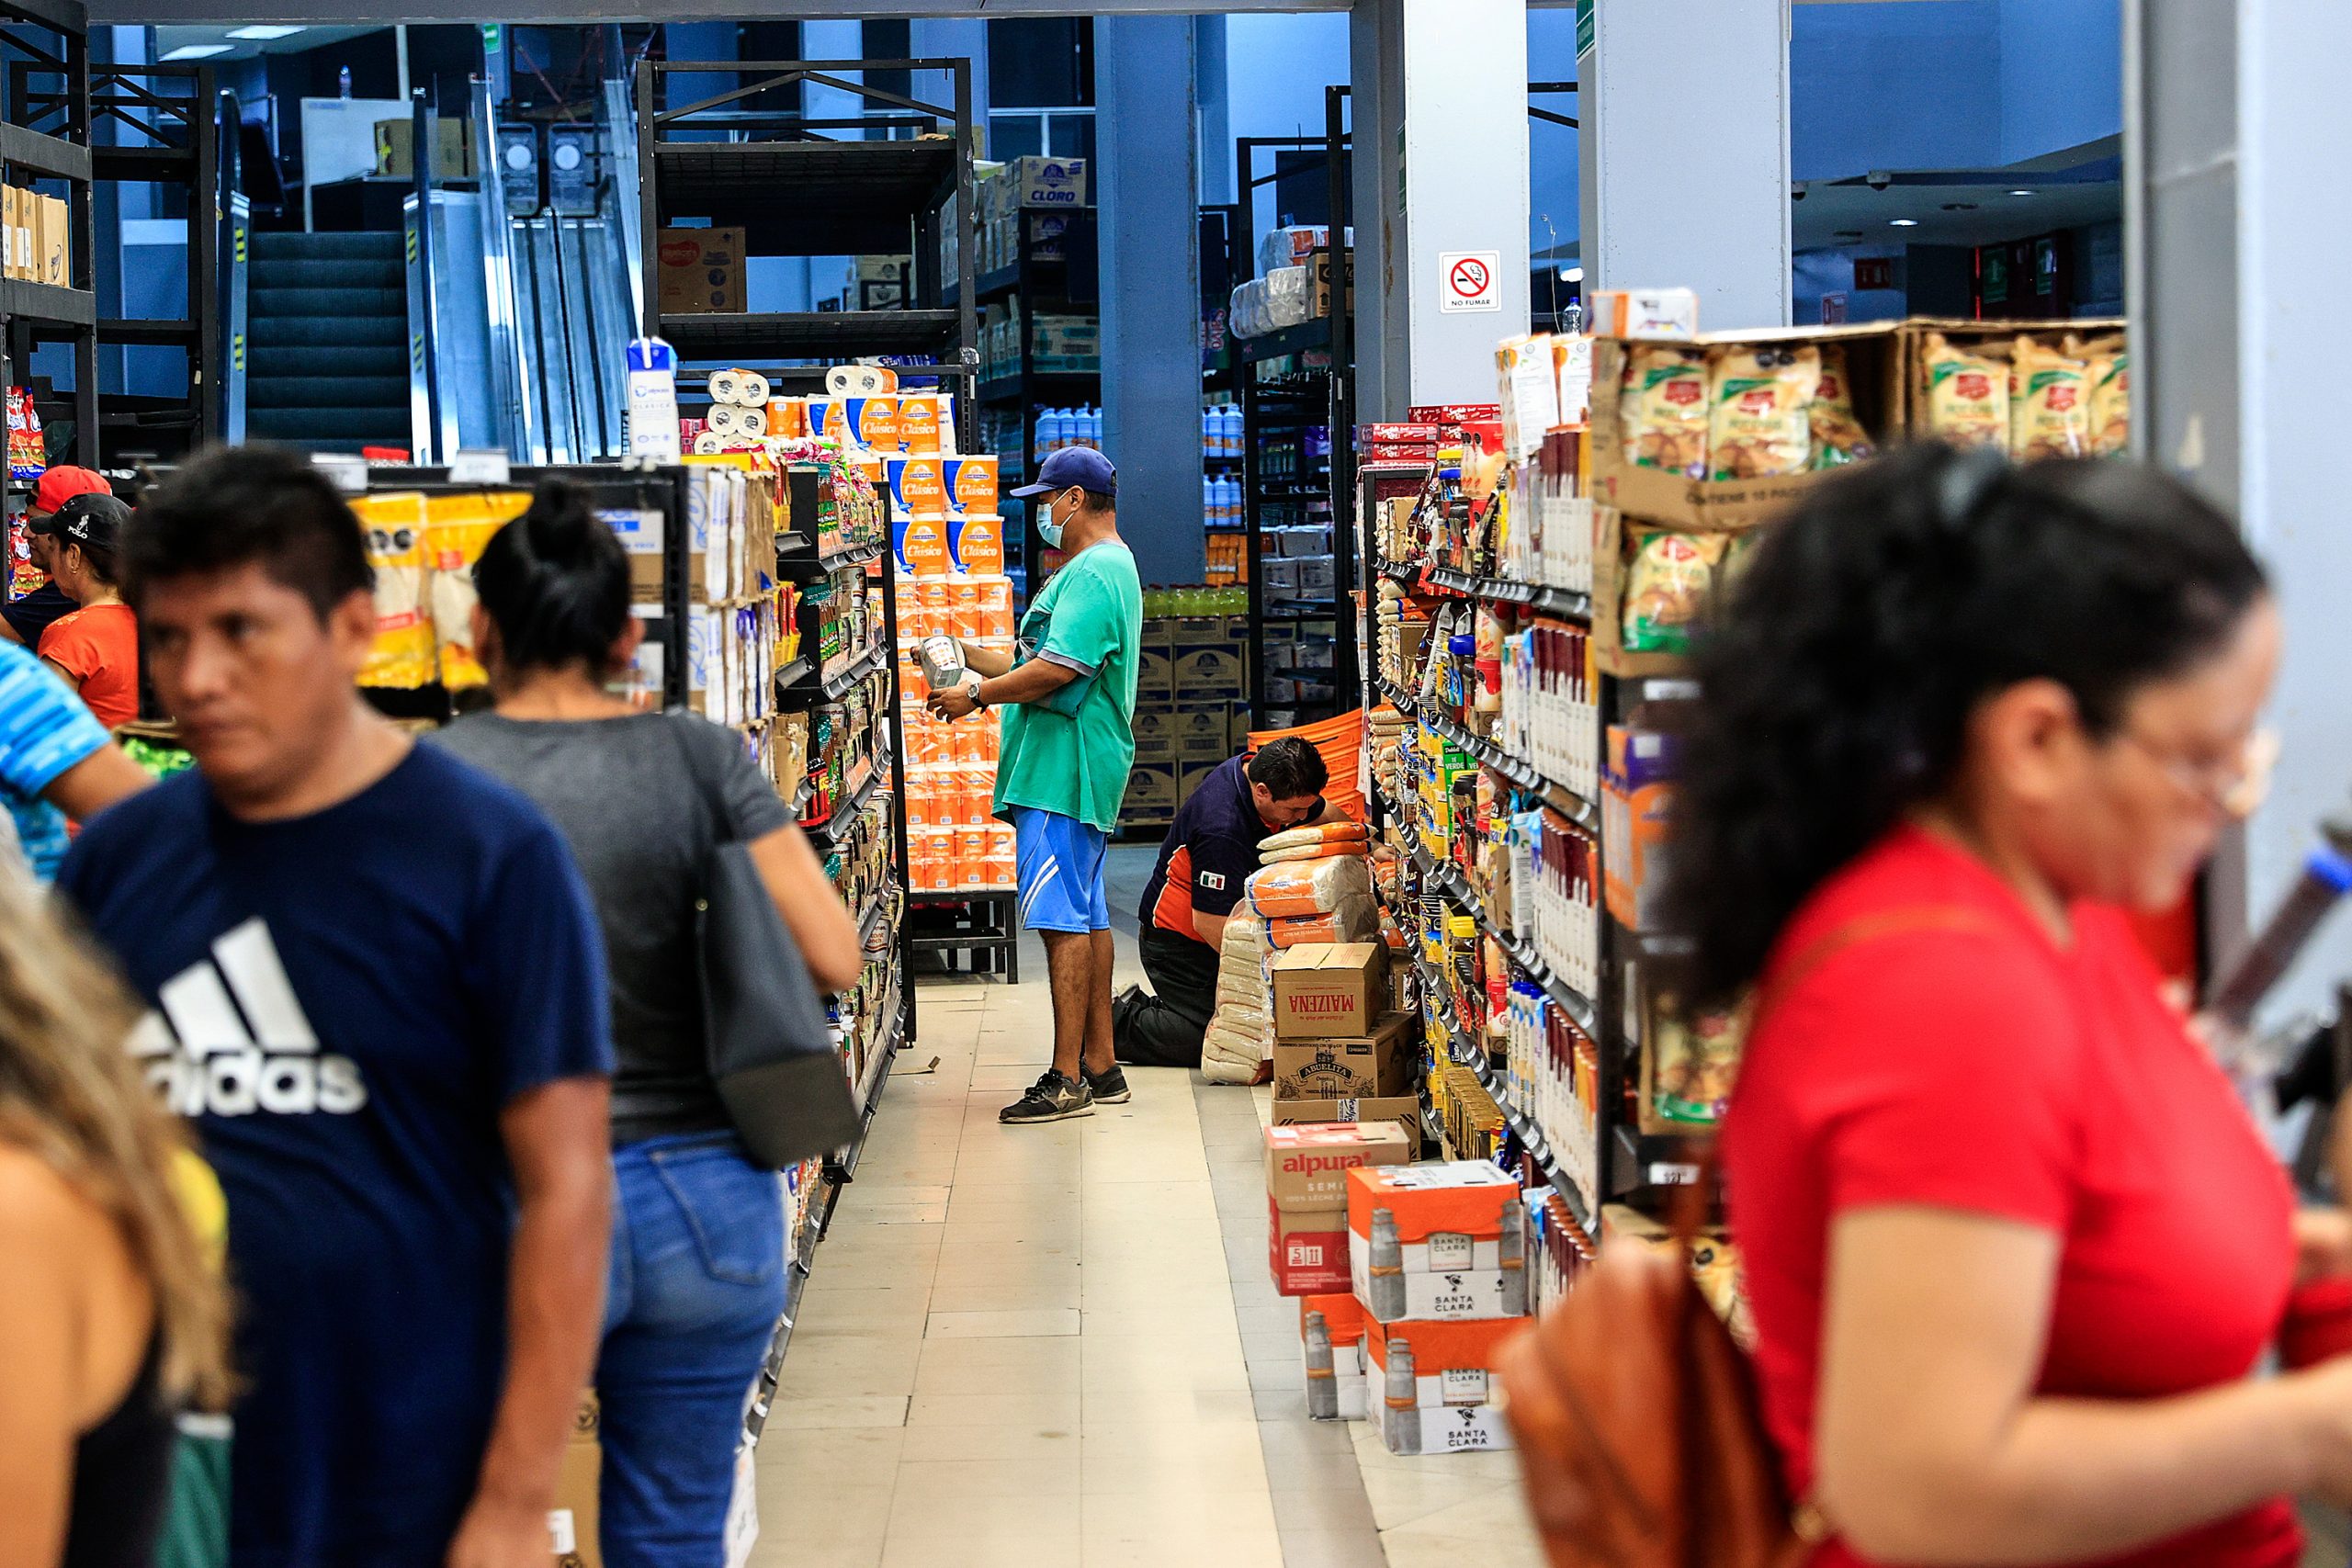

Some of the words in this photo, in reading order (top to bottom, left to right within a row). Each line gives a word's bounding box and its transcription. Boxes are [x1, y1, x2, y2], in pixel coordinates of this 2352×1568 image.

[1032, 190, 1076, 202] CLORO
[1210, 309, 1226, 351] Salvo
[863, 421, 897, 435] Clásico
[900, 422, 936, 435] Clásico
[904, 482, 939, 496] Clásico
[958, 483, 994, 497] Clásico
[67, 525, 88, 539] POLO
[907, 544, 942, 557] Clásico
[962, 544, 998, 558] Clásico
[1445, 761, 1464, 770] VERDE
[1288, 994, 1354, 1013] MAIZENA
[1305, 1063, 1347, 1077] ABUELITA
[1283, 1152, 1364, 1178] alpura
[1433, 1244, 1467, 1252] CLARA
[1434, 1295, 1475, 1303] SANTA
[1434, 1303, 1475, 1312] CLARA
[1448, 1429, 1487, 1438] SANTA
[1448, 1438, 1488, 1447] CLARA
